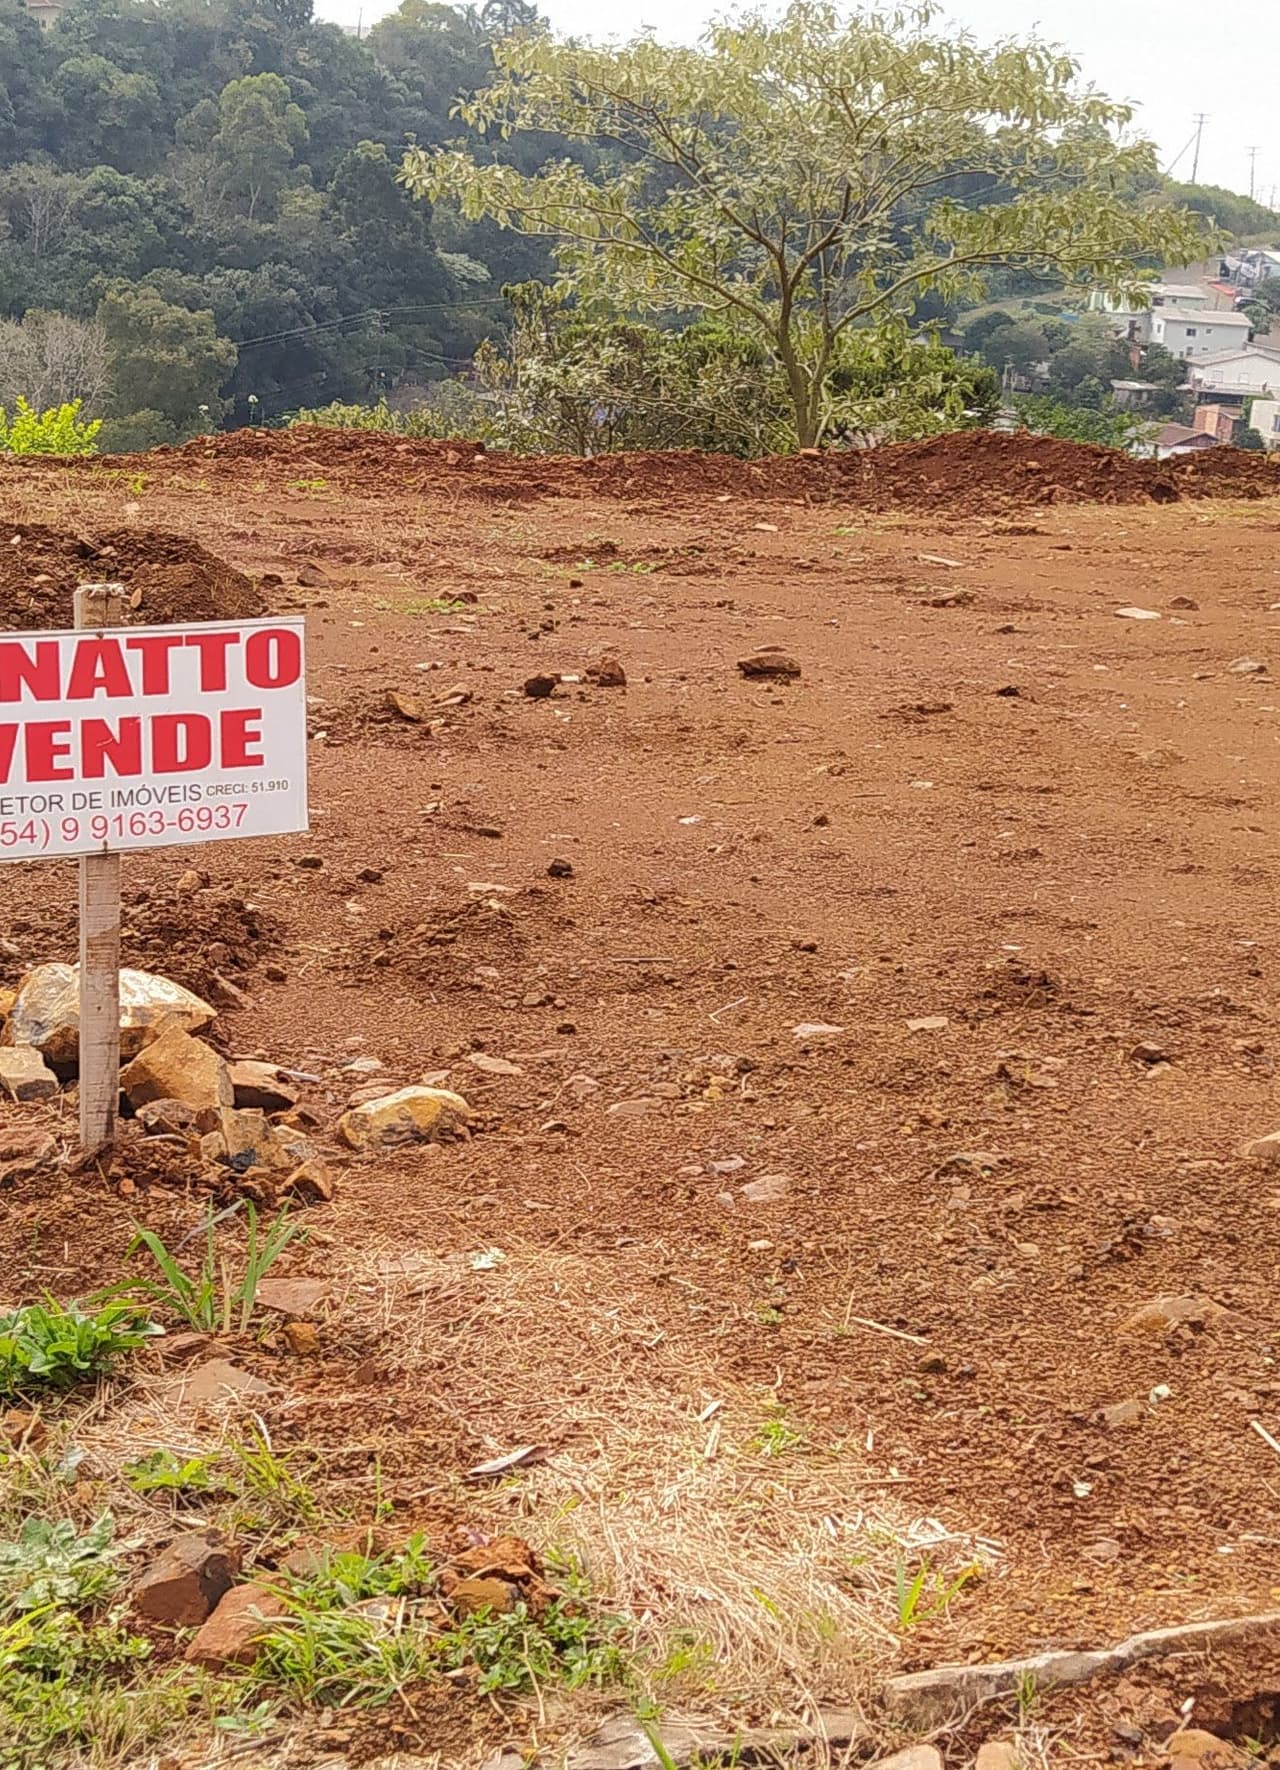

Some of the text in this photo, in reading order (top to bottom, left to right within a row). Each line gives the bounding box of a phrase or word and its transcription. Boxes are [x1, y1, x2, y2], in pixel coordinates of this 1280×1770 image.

[71, 792, 104, 811] DE
[110, 783, 203, 808] IMÓVEIS
[206, 783, 249, 797] CRECI:
[251, 780, 289, 793] 51.910
[61, 818, 80, 842] 9
[90, 803, 249, 840] 9163-6937
